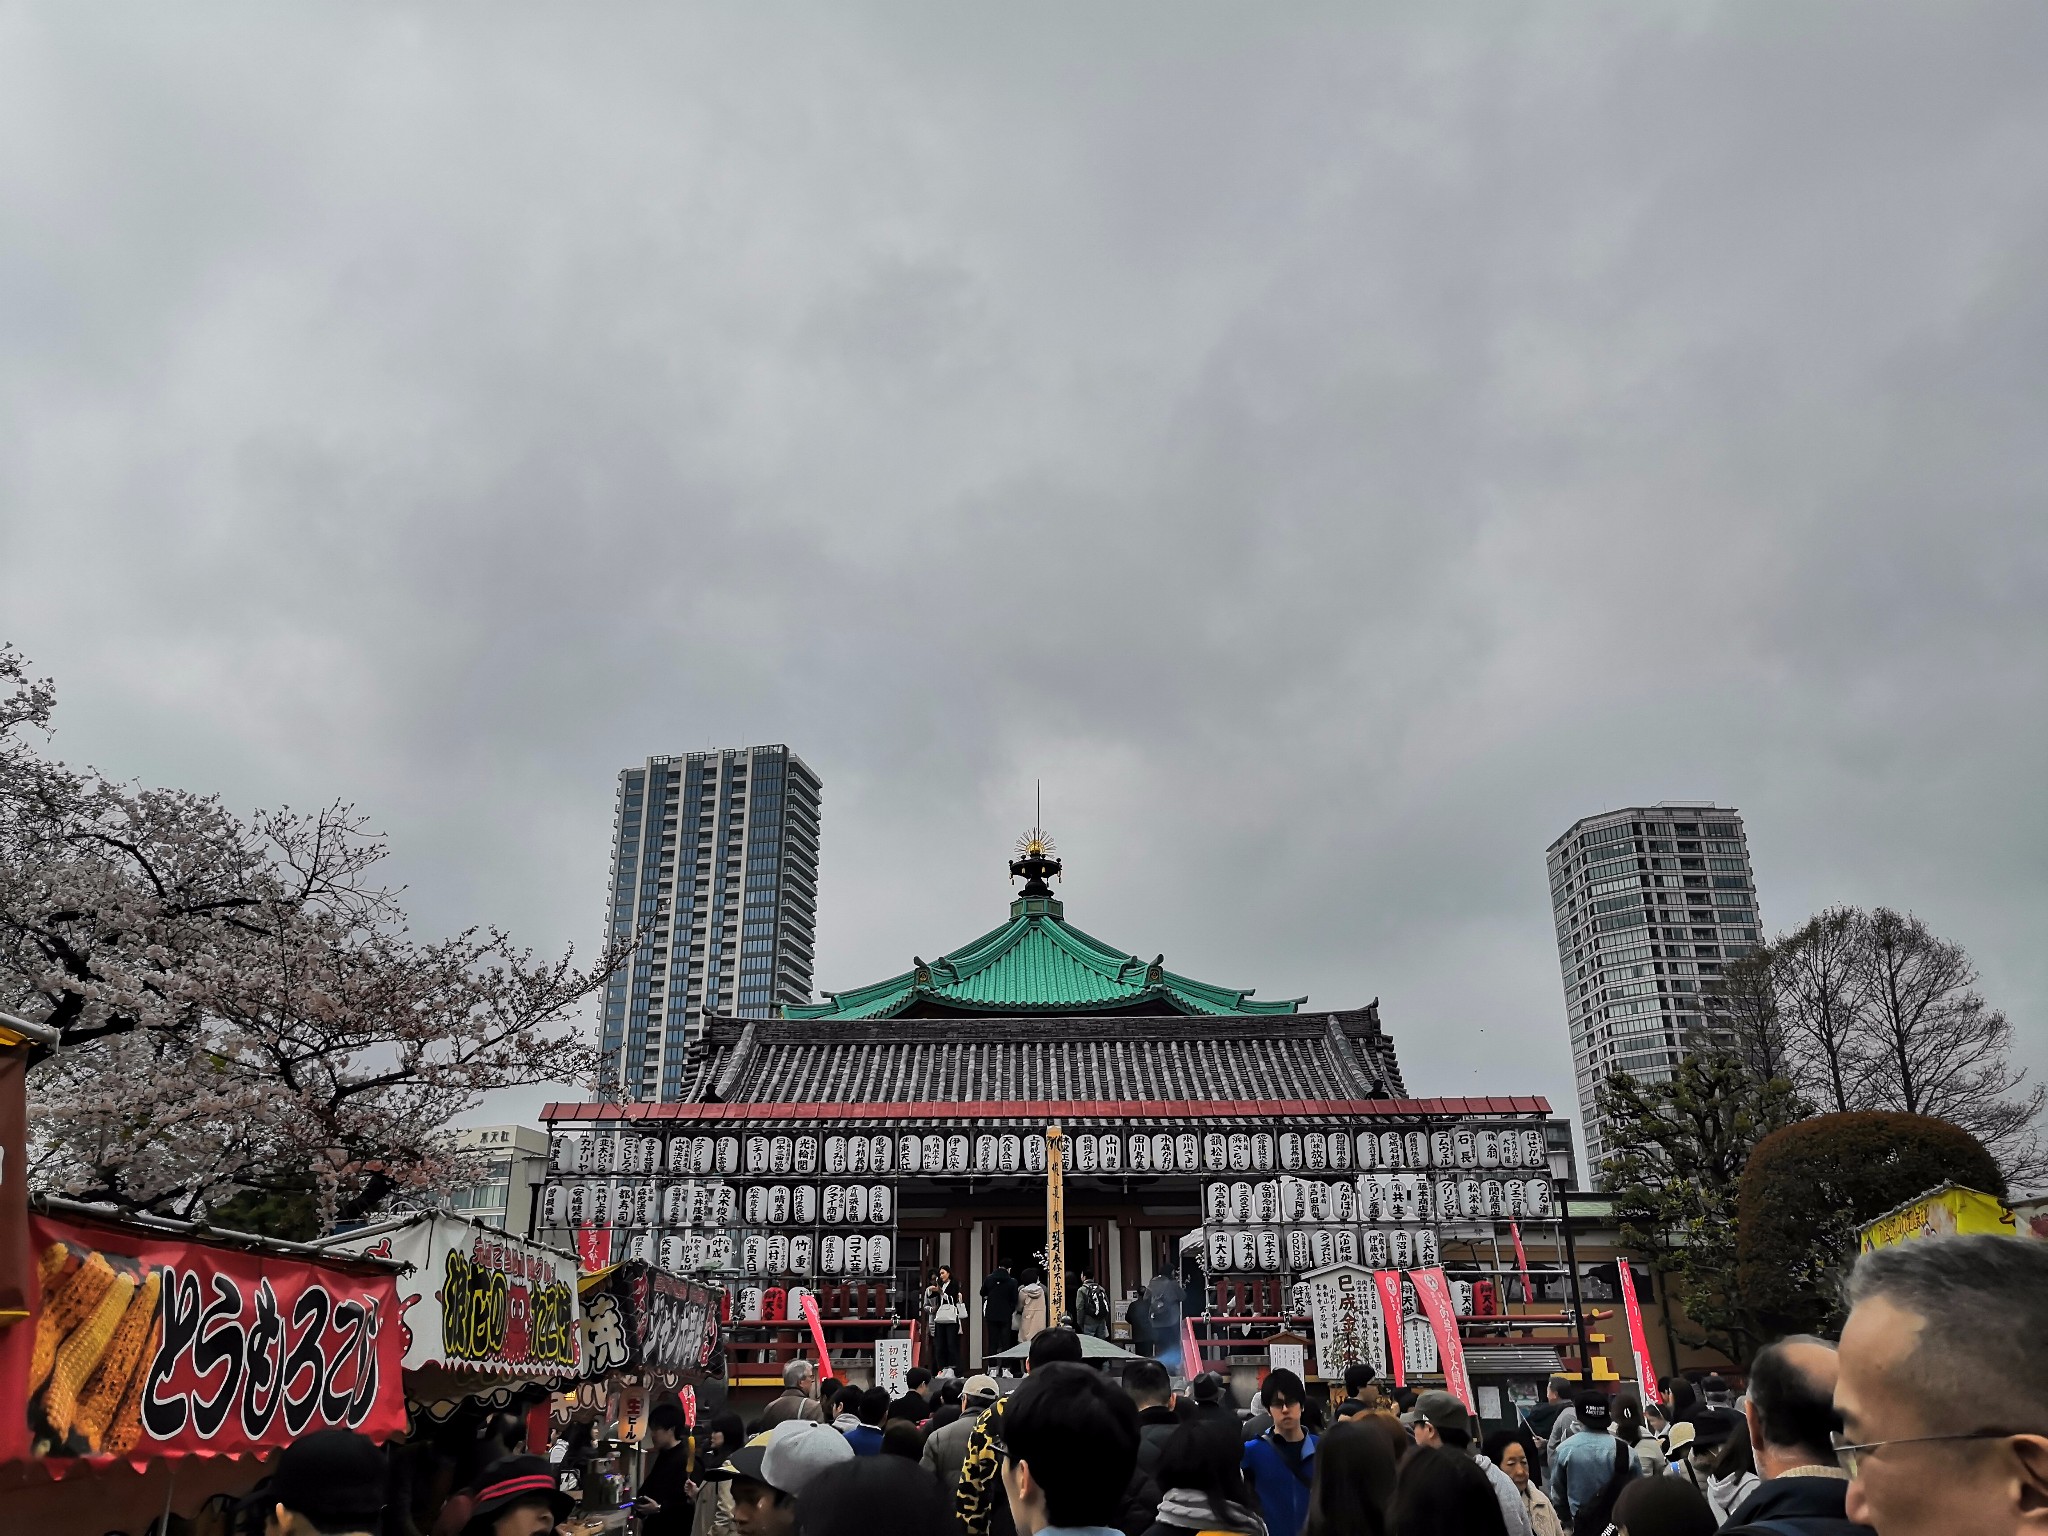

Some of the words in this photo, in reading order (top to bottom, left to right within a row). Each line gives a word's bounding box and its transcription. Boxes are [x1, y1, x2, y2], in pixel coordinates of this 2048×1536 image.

[578, 1138, 591, 1171] カナリヤ
[1106, 1137, 1117, 1168] 山川豊
[1438, 1132, 1450, 1166] コムウェル
[1527, 1132, 1540, 1165] はせがわ
[1467, 1183, 1481, 1215] 松栄堂
